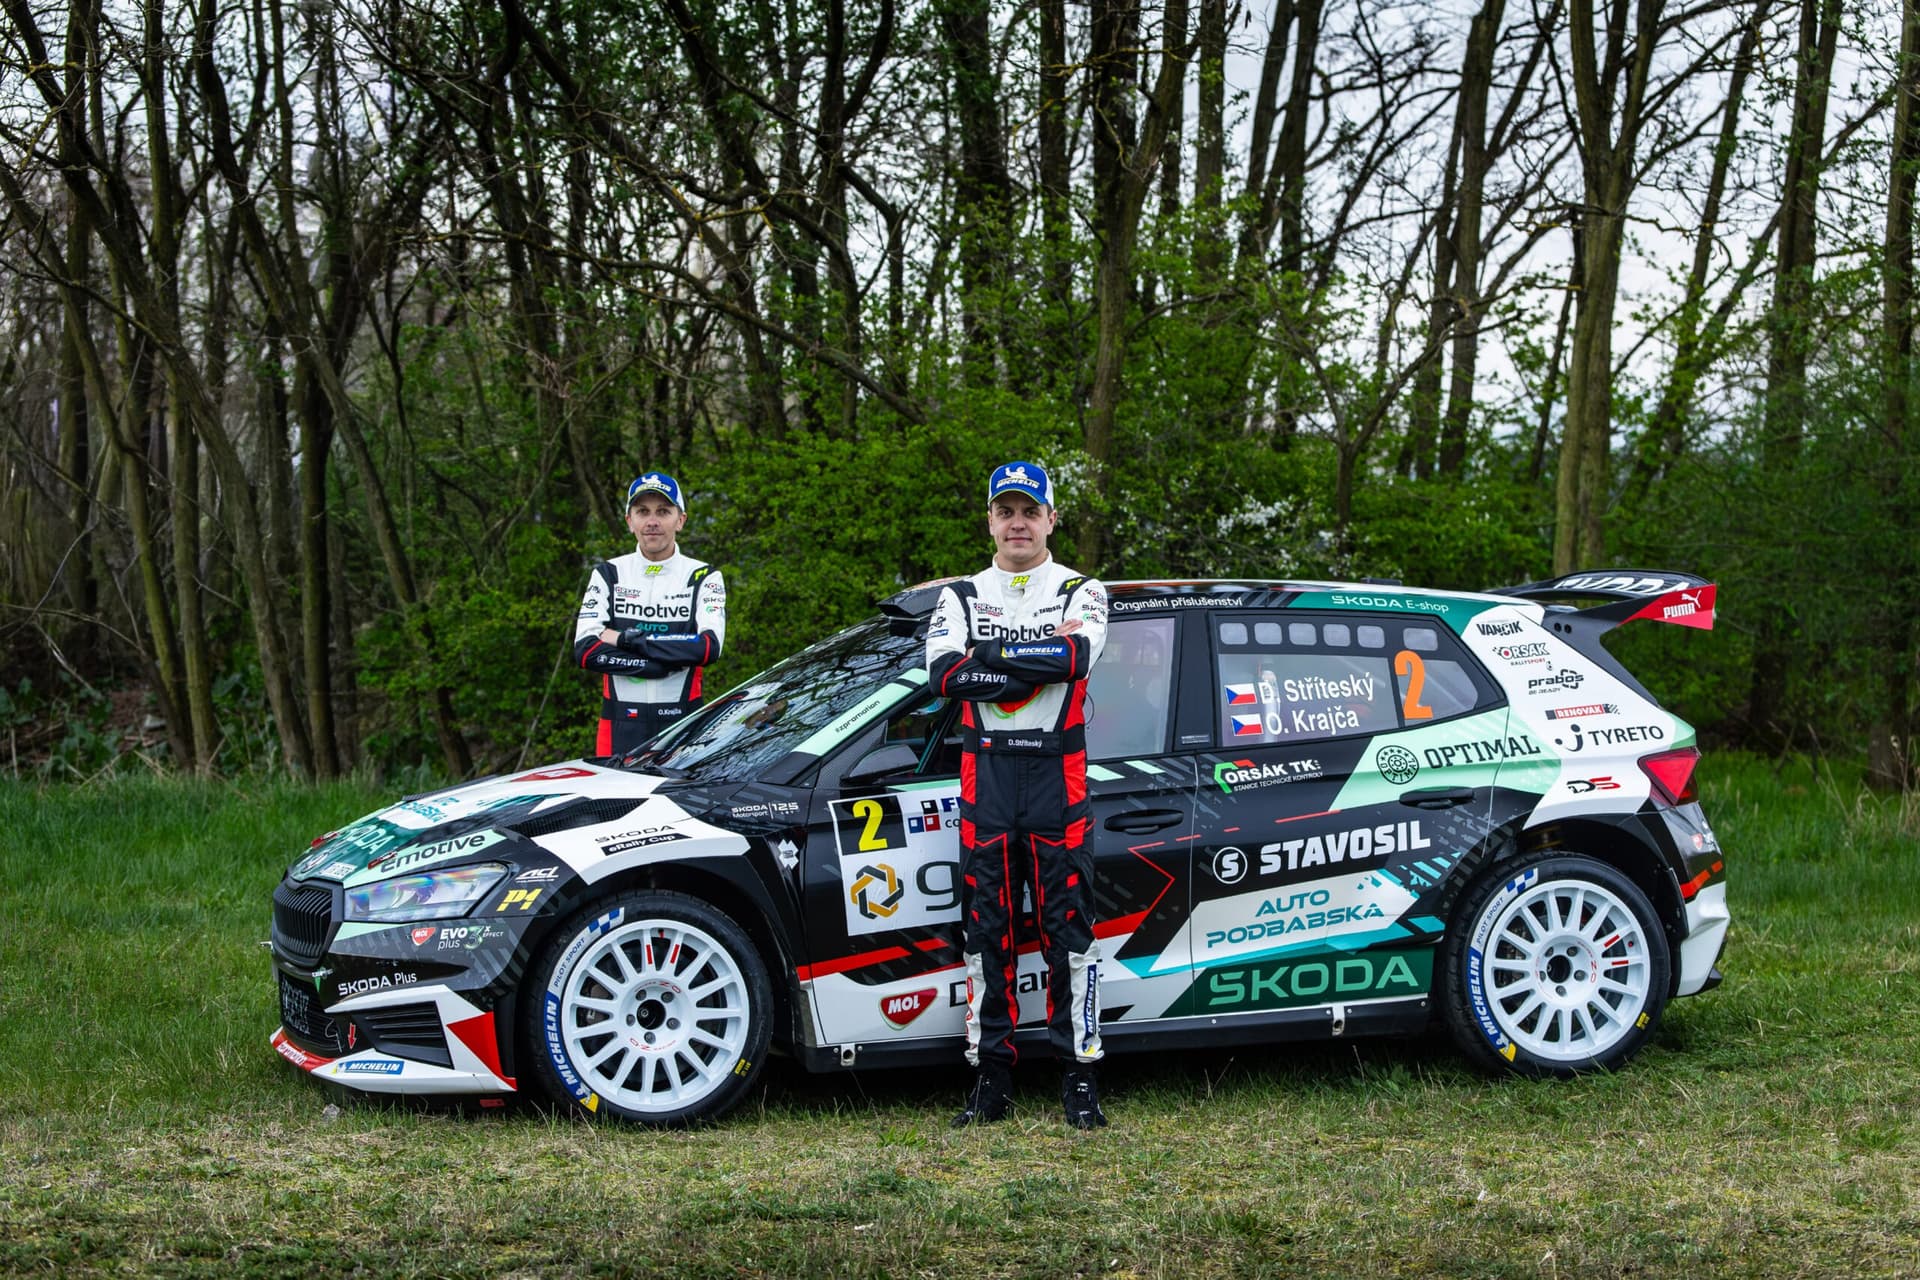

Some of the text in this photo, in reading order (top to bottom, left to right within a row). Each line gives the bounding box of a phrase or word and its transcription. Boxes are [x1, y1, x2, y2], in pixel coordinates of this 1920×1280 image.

[614, 597, 690, 618] Emotive
[1113, 596, 1243, 611] Originální příslušenství
[1406, 600, 1449, 614] E-shop
[1663, 602, 1696, 619] PUMA
[636, 623, 669, 632] AUTO
[977, 617, 1055, 644] Emotive
[1016, 646, 1063, 654] MICHELIN
[608, 656, 648, 667] STAVOS
[971, 672, 1008, 684] STAVO
[1258, 671, 1375, 705] D. Stříteský
[1394, 650, 1433, 719] 2
[1528, 674, 1584, 689] prabos
[1265, 705, 1359, 736] O. Krajča
[1557, 706, 1603, 719] RENOVAK
[1589, 726, 1664, 746] TYRETO
[1423, 735, 1541, 769] OPTIMAL
[1225, 763, 1288, 784] ORSÁK
[771, 802, 799, 811] 125
[852, 799, 889, 852] 2
[380, 833, 485, 874] Emotive
[609, 833, 677, 853] eRally Cup
[1259, 820, 1431, 876] STAVOSIL
[496, 888, 544, 912] P1
[1255, 890, 1330, 918] AUTO
[1476, 896, 1505, 945] PILOT SPORT
[414, 930, 428, 938] MOL
[437, 937, 461, 951] plus
[440, 927, 468, 940] EVO
[464, 926, 485, 950] 3
[553, 937, 586, 988] PILOT SPORT
[394, 972, 417, 986] Plus
[888, 994, 921, 1015] MOL
[1086, 970, 1095, 1033] MICHELIN
[1469, 956, 1498, 1036] MICHELIN
[547, 1000, 578, 1086] MICHELIN
[349, 1062, 400, 1072] MICHELIN
